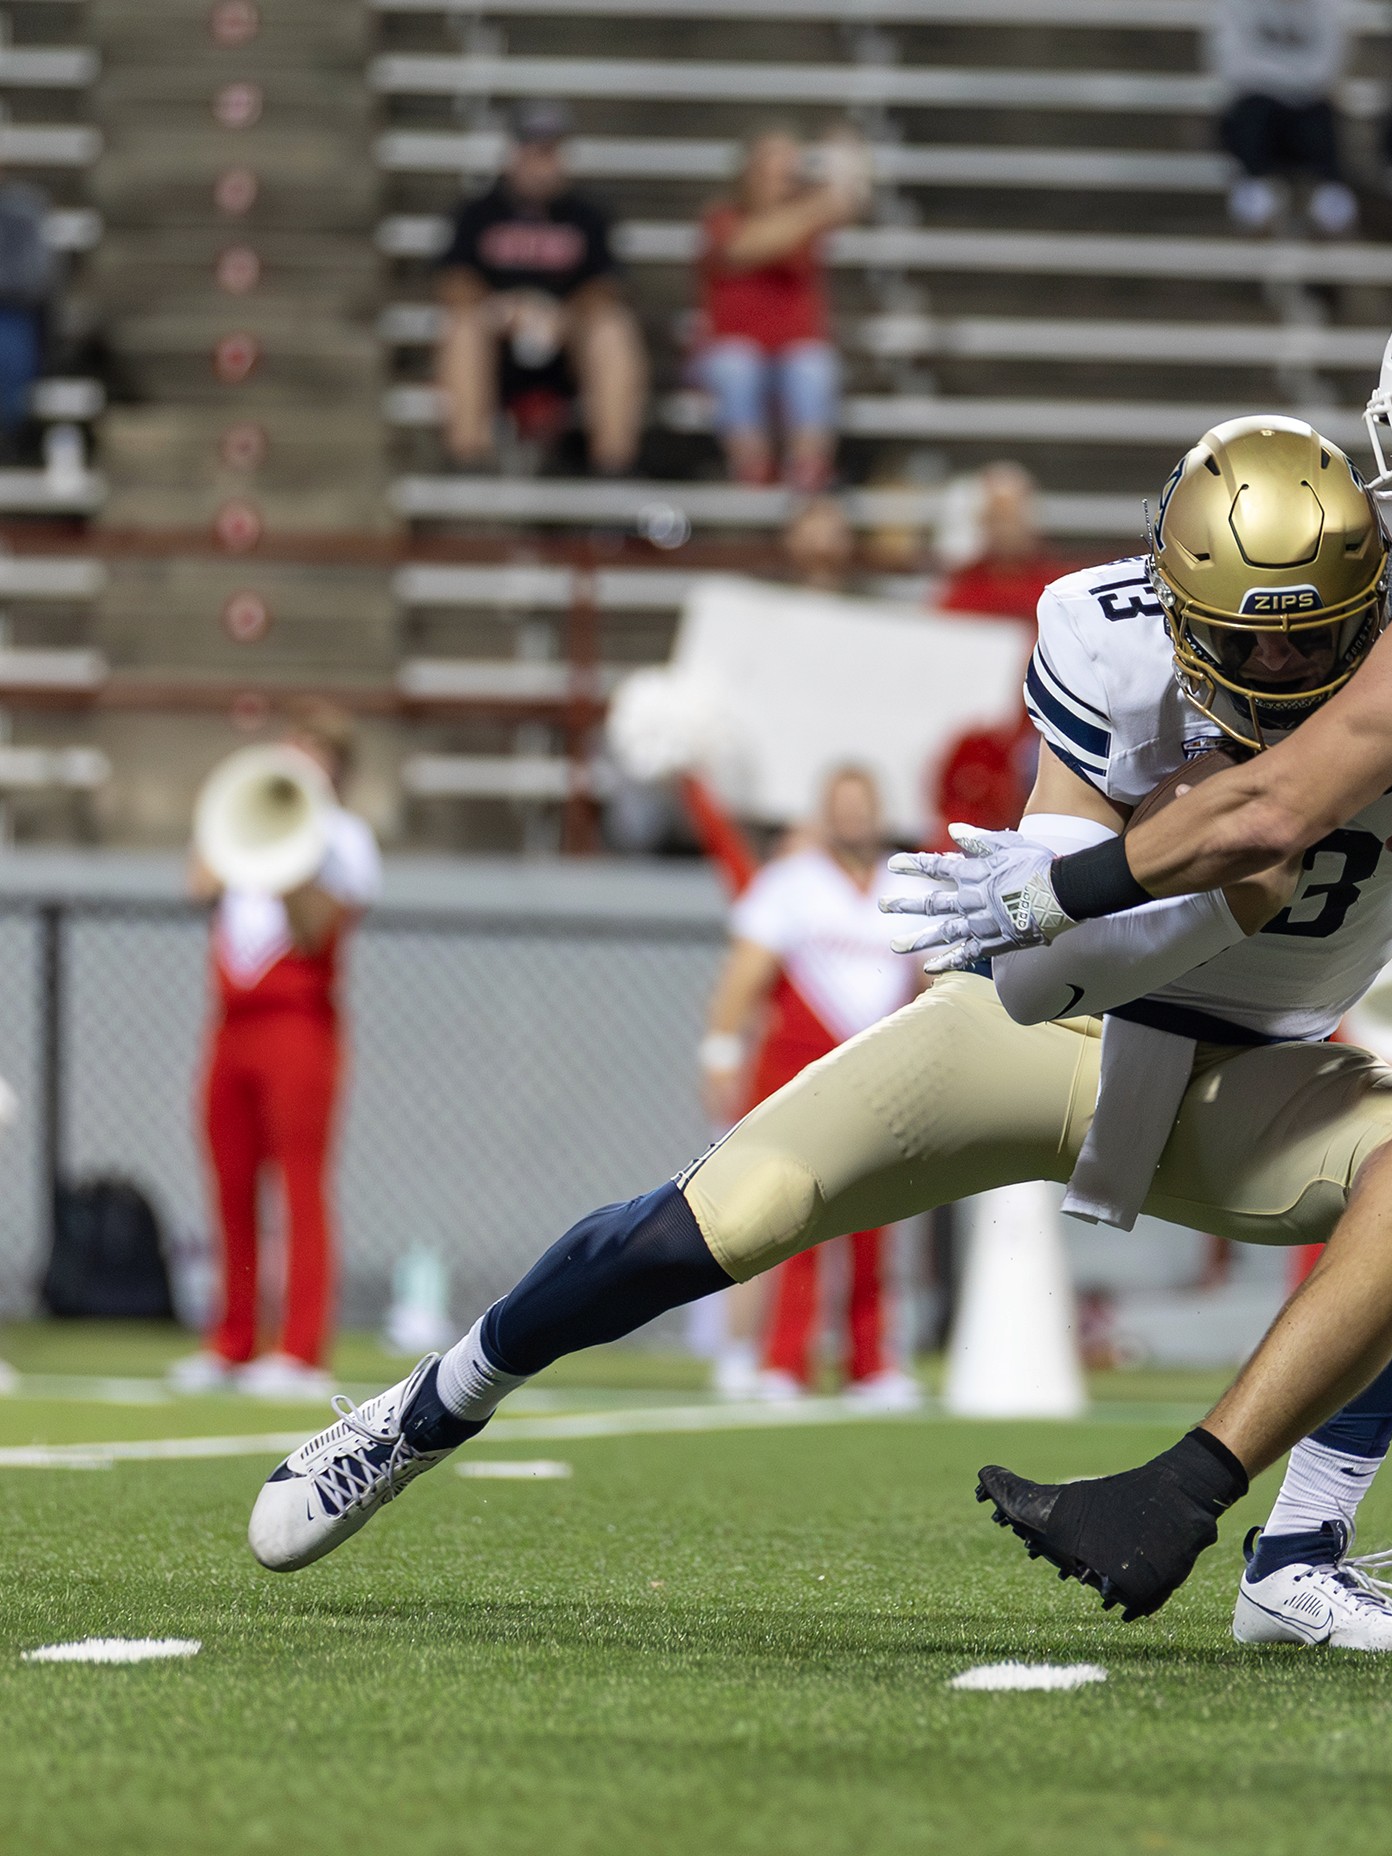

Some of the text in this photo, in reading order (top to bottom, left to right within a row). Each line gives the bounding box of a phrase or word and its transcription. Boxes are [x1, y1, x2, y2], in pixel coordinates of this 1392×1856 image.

[1088, 576, 1165, 622] 13
[1254, 592, 1314, 610] ZIPS
[1259, 827, 1384, 938] 3
